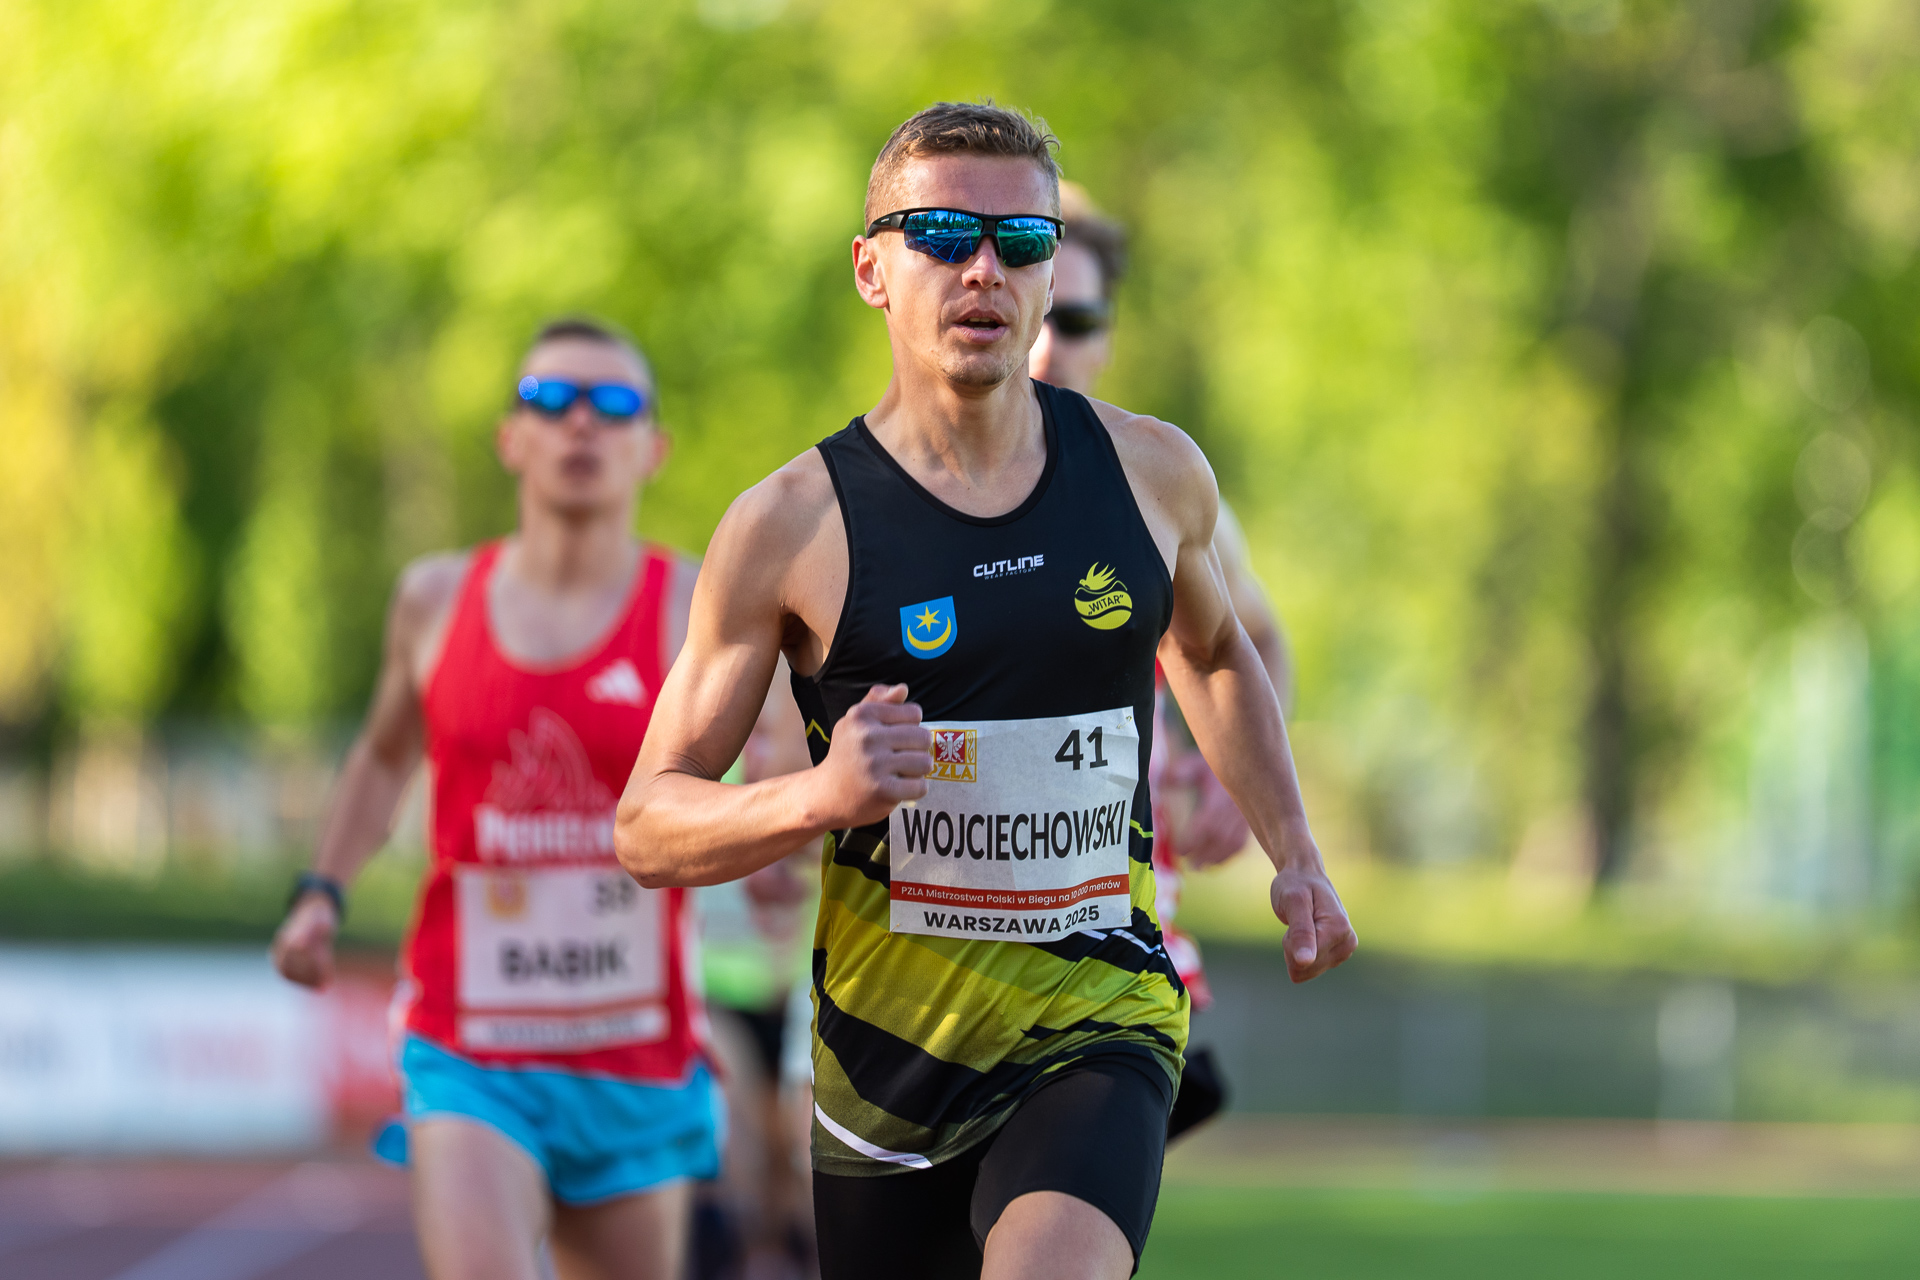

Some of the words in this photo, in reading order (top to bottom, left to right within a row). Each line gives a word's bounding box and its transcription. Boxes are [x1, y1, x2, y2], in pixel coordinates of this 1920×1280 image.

[973, 554, 1044, 577] CUTLINE
[1055, 726, 1108, 770] 41
[902, 800, 1126, 861] WOJCIECHOWSKI
[901, 886, 924, 896] PZLA
[926, 889, 984, 902] Mistrzostwa
[986, 894, 1015, 904] Polski
[1028, 894, 1056, 906] Biegu
[1058, 894, 1070, 902] na
[1089, 880, 1120, 892] metrów
[923, 911, 1061, 934] WARSZAWA
[1064, 905, 1099, 930] 2025
